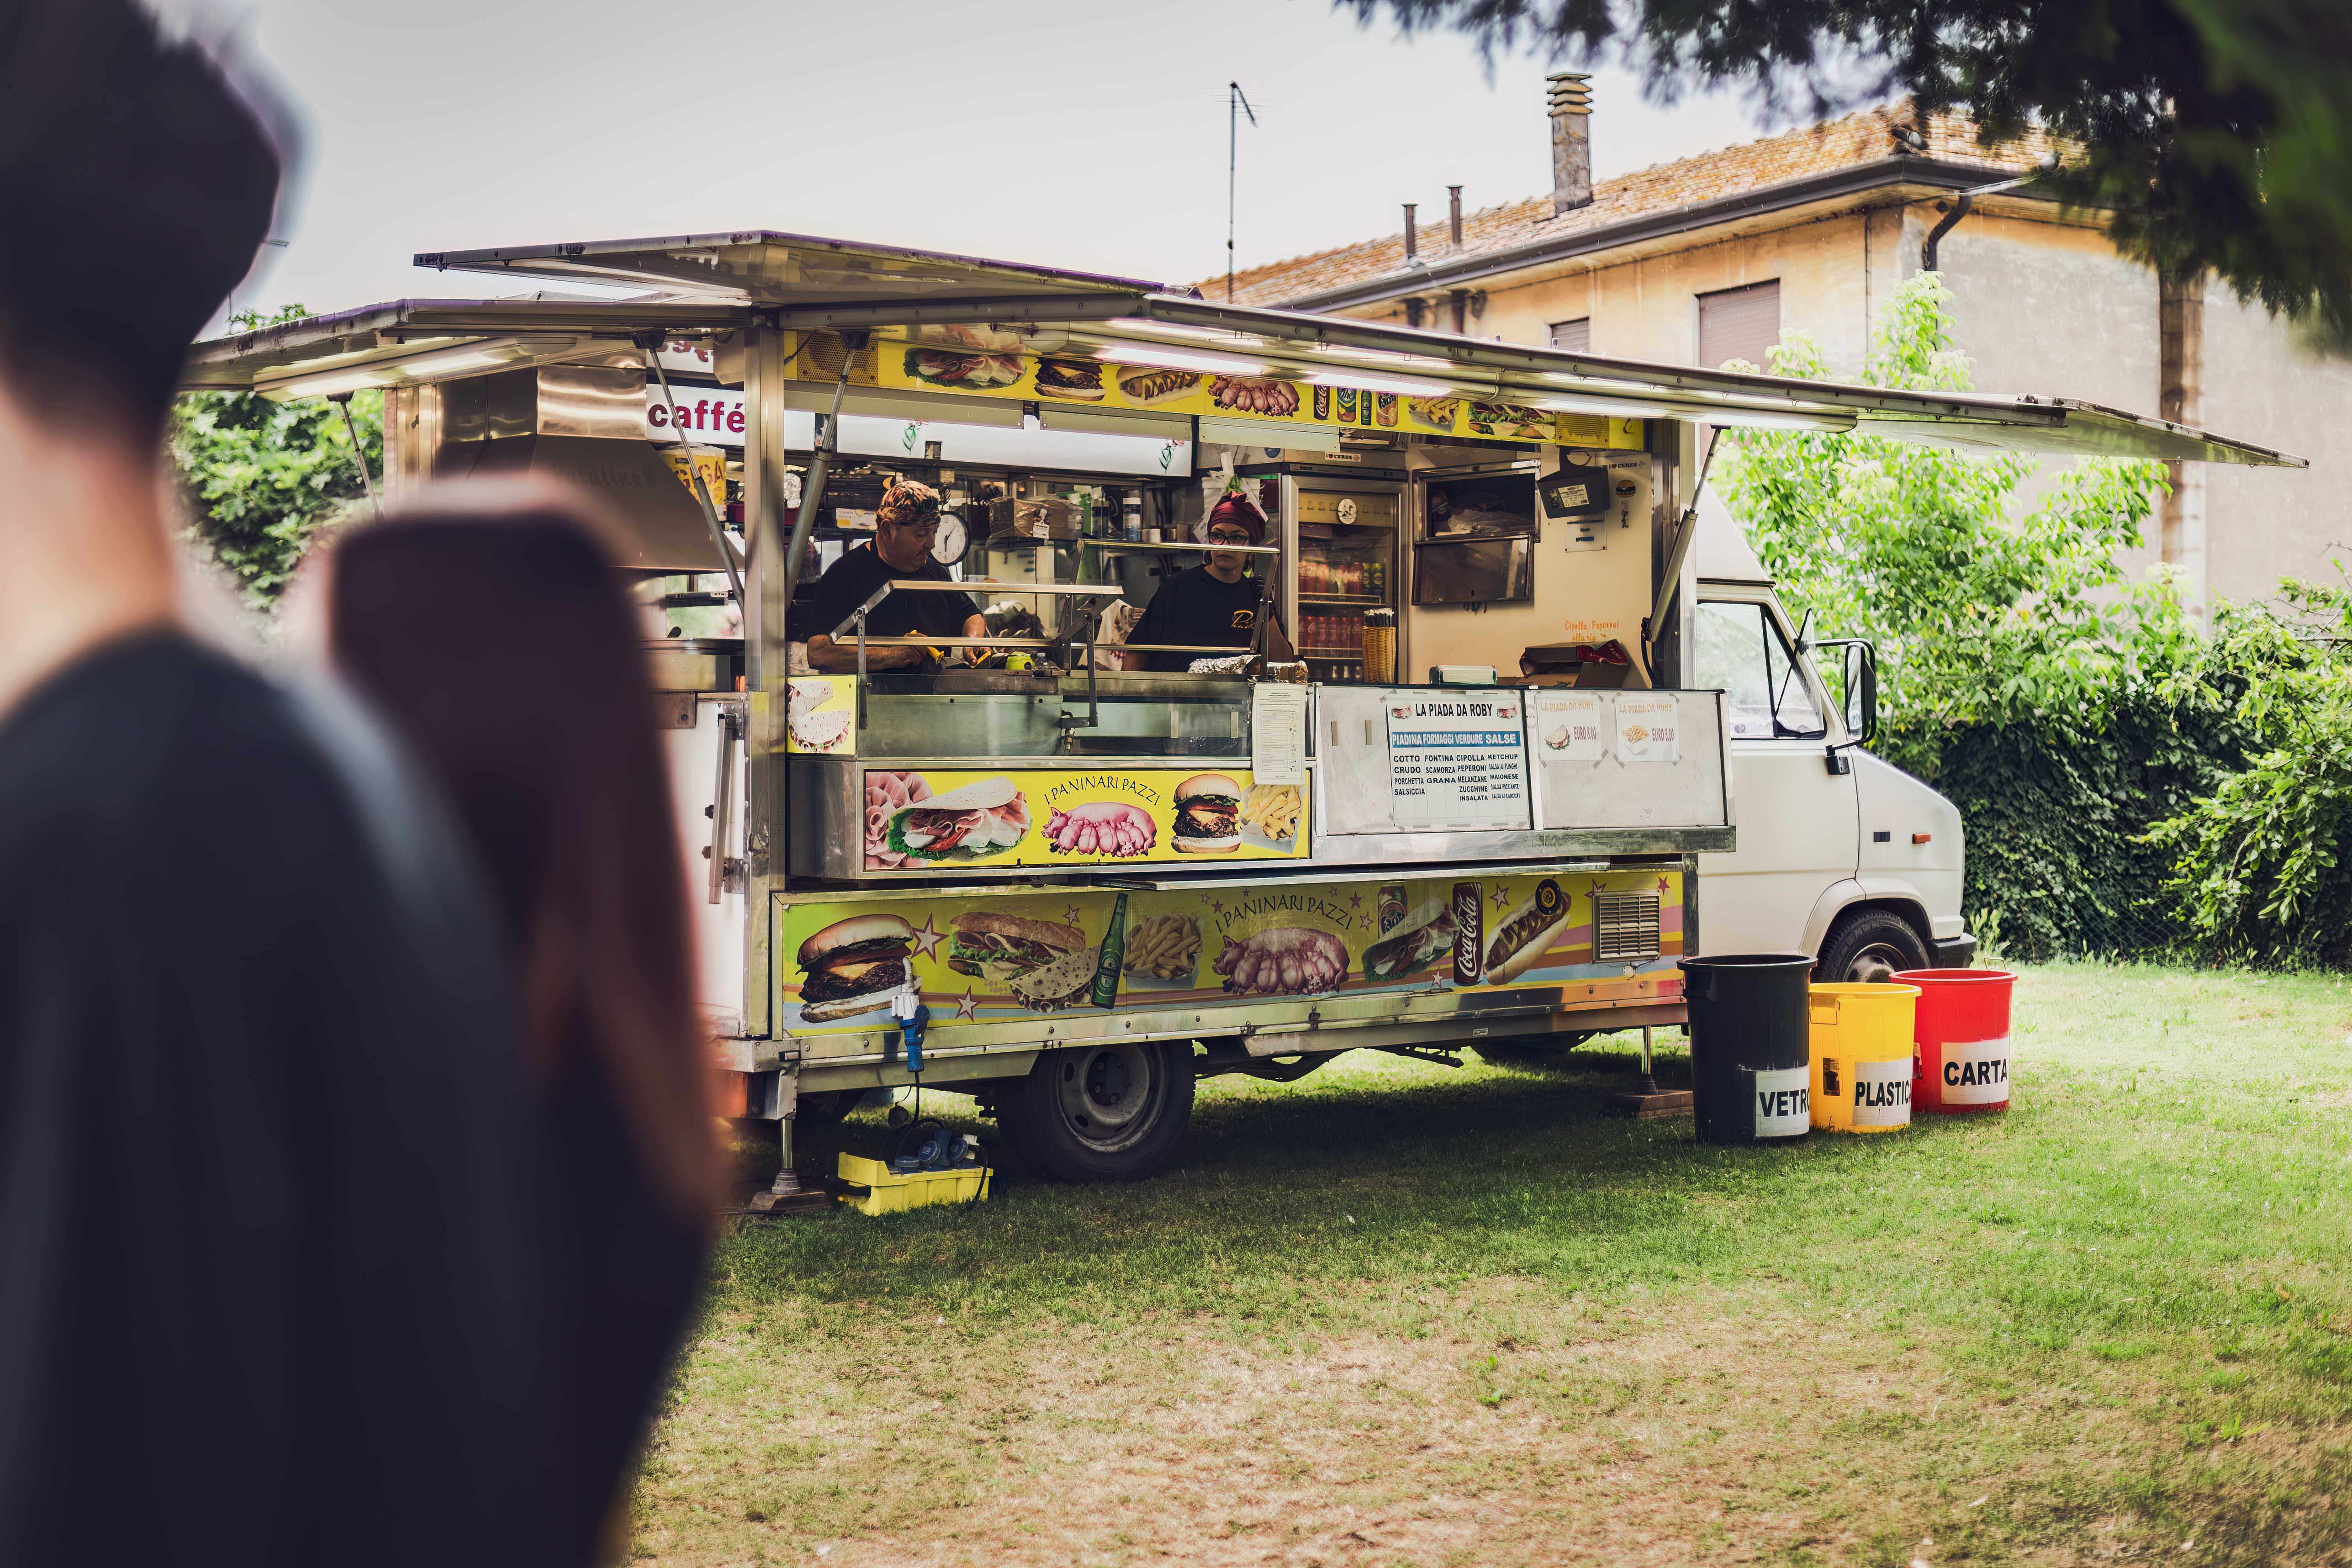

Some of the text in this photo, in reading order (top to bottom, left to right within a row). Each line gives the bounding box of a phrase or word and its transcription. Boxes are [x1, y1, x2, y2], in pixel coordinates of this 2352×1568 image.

[648, 400, 745, 433] caffé
[674, 461, 724, 490] GGA
[1565, 620, 1587, 632] Cipolla
[1572, 633, 1585, 642] alla
[1416, 703, 1493, 717] LA PIADA DA ROBY
[1541, 700, 1594, 712] LA PIADA DA ROBY
[1619, 702, 1672, 714] LA PIADA DA ROBY
[1392, 734, 1422, 745] PIADINA
[1423, 733, 1453, 745] FORMAGGI
[1455, 734, 1483, 744] VERDURE
[1485, 734, 1517, 744] SALSE
[1574, 726, 1586, 740] EURO
[1652, 728, 1665, 742] EURO
[1044, 776, 1160, 806] I PANINARI PAZZI
[1215, 894, 1353, 934] I PANINARI PAZZI
[1944, 1058, 2008, 1086] CARTA
